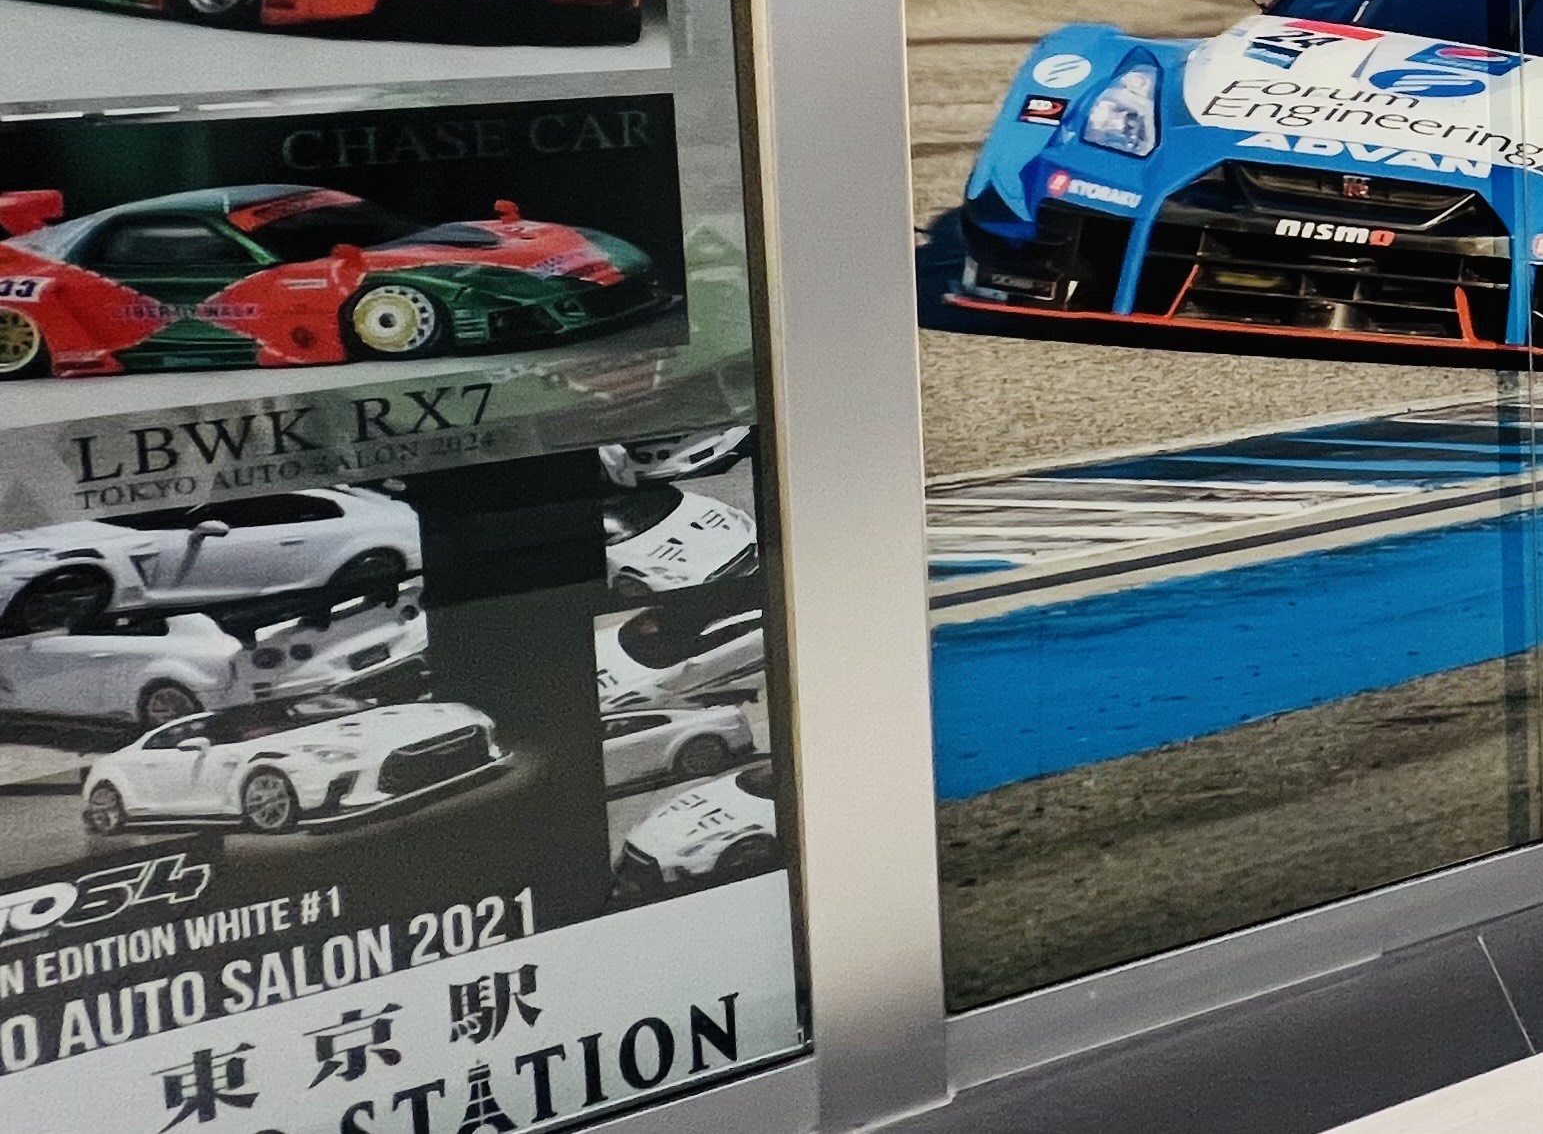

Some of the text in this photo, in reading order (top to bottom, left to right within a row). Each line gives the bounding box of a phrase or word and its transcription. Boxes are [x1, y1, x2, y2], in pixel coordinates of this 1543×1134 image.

[1221, 78, 1421, 109] Forum
[281, 110, 650, 170] CHASE CAR
[1236, 132, 1492, 179] ADVAN
[1274, 219, 1396, 247] nismo
[71, 382, 493, 484] LBWK RX7
[75, 475, 197, 510] TOKYO
[212, 458, 300, 490] AUTO
[310, 437, 424, 477] SALON
[36, 923, 177, 988] EDITION
[184, 897, 292, 951] WHITE
[299, 885, 342, 926] #1
[57, 970, 206, 1060] AUTO
[221, 923, 394, 1015] SALON
[408, 886, 536, 968] 2021
[150, 963, 543, 1134] 東京駅
